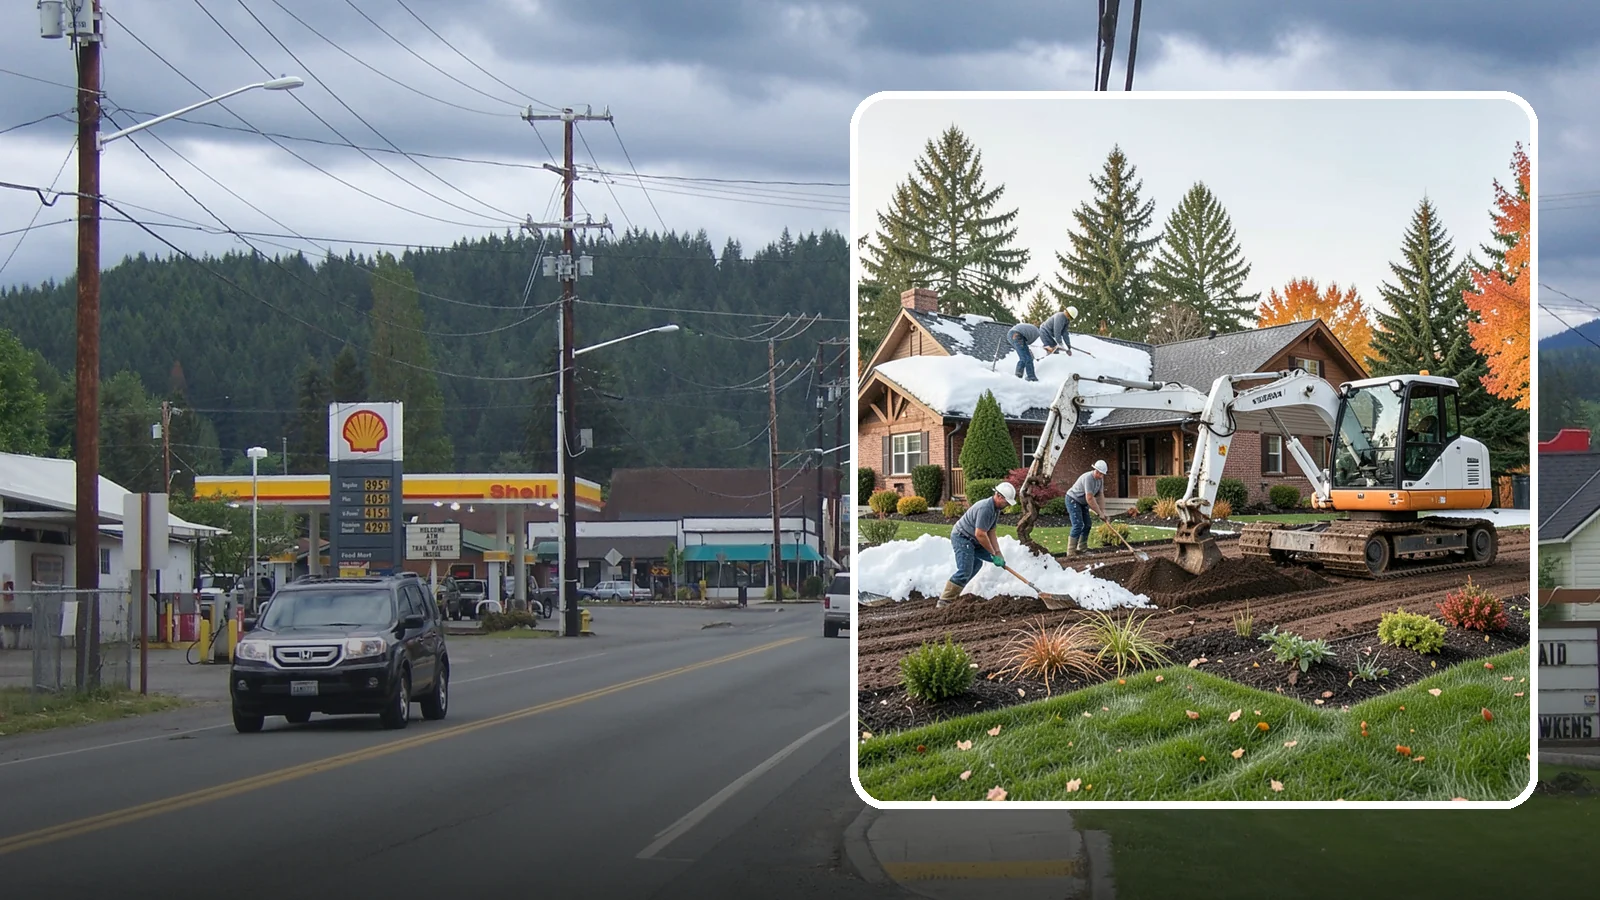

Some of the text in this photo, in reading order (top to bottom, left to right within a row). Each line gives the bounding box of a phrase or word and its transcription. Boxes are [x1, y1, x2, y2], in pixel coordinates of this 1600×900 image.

[366, 480, 383, 489] 395
[490, 484, 547, 498] Shell
[366, 494, 383, 504] 405
[366, 508, 382, 517] 415
[366, 522, 383, 532] 429
[1539, 643, 1566, 666] AID
